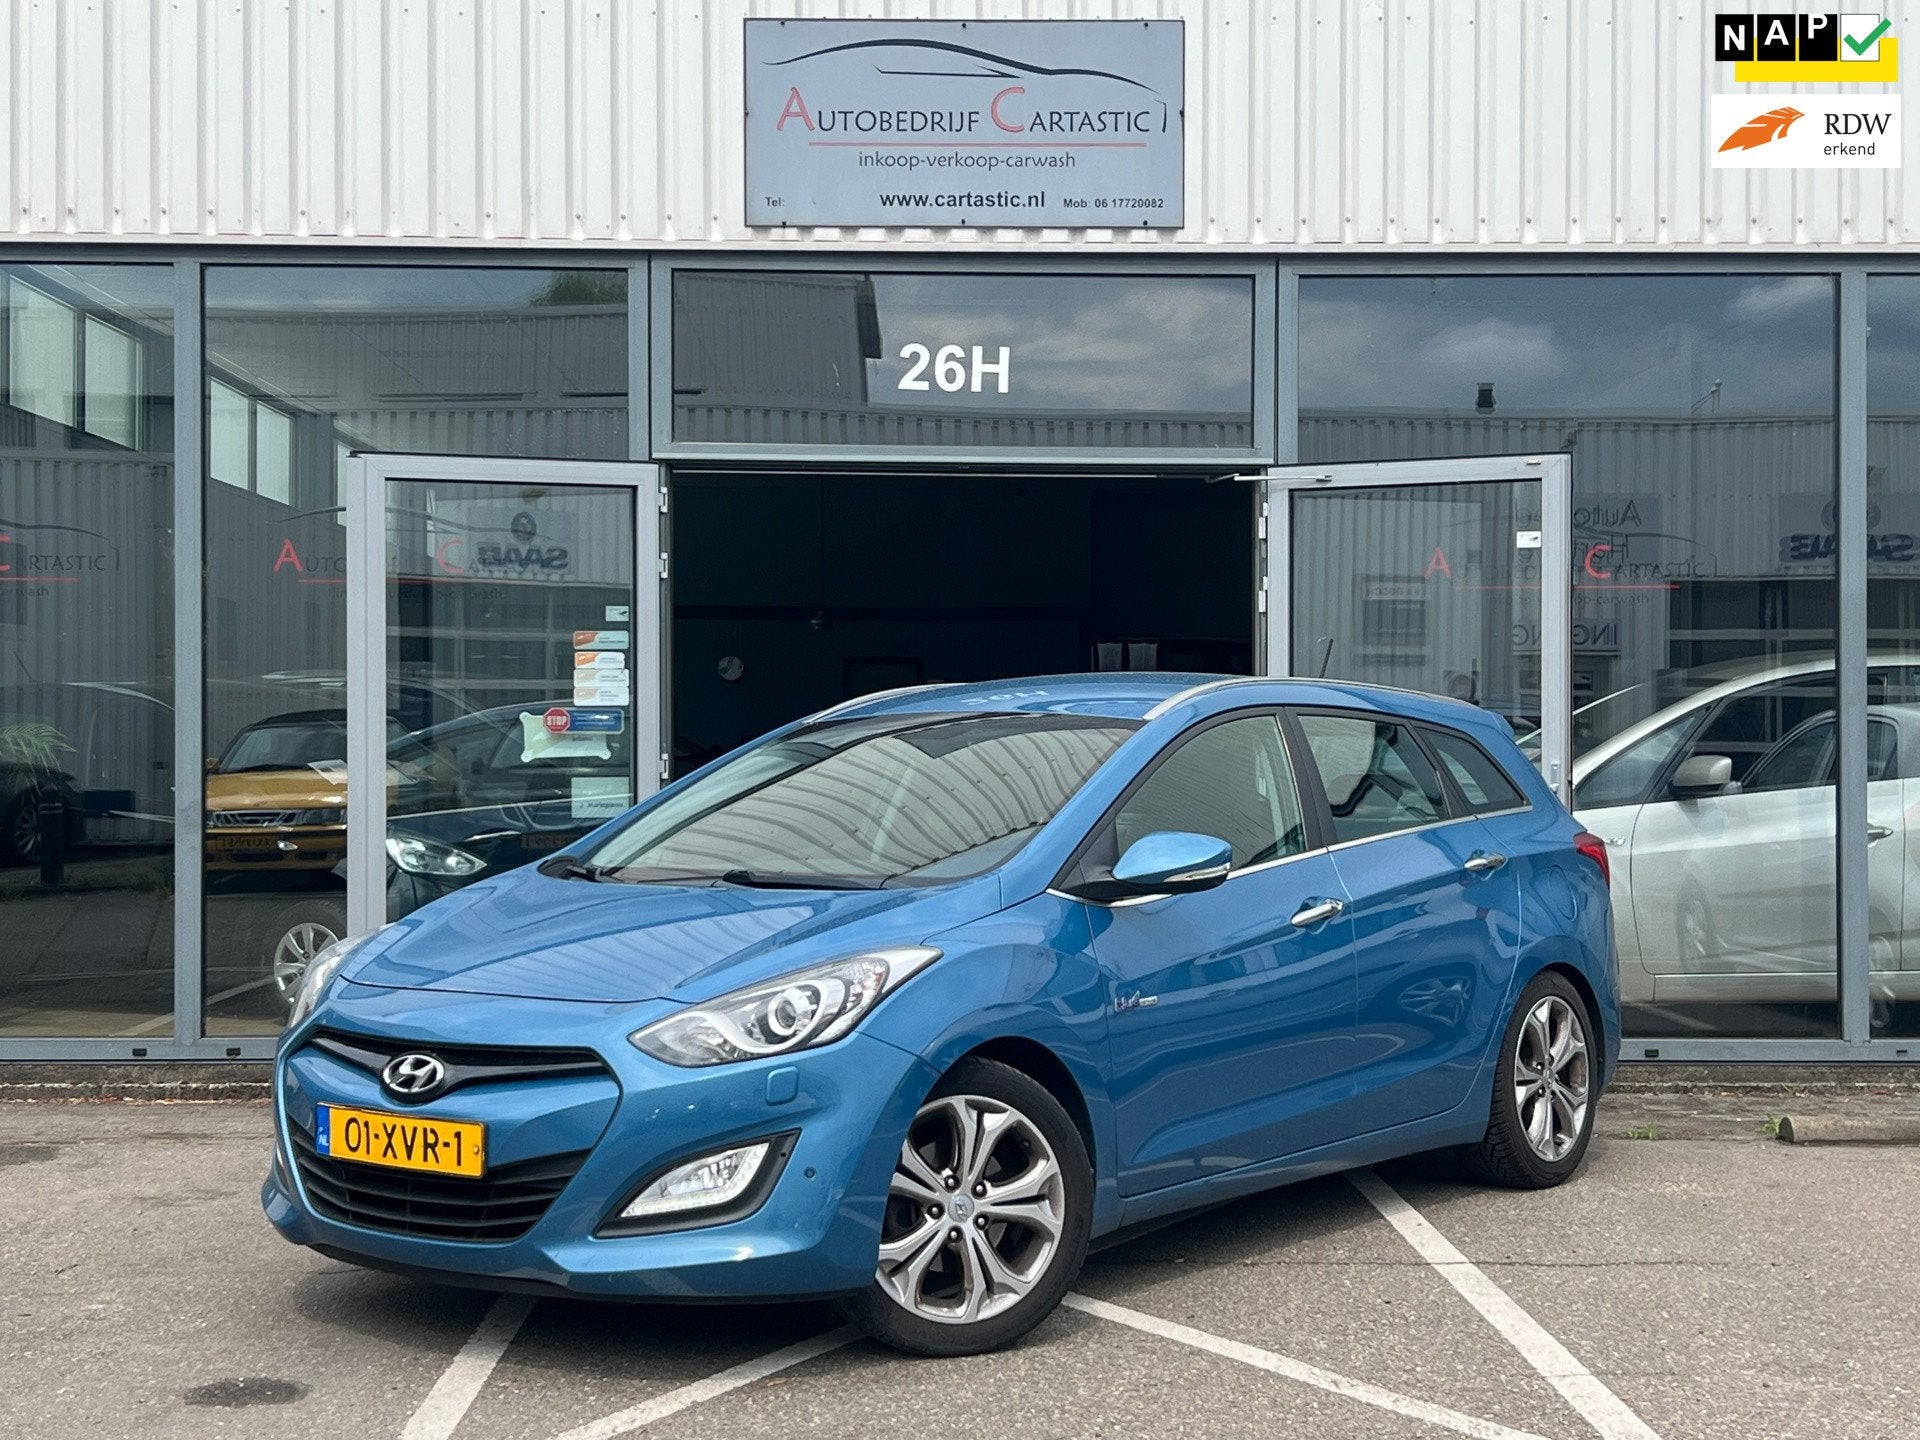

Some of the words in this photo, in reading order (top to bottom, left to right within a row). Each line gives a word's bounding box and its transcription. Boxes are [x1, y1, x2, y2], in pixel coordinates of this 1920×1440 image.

[858, 151, 1076, 171] inkoop-verkoop-carwash
[765, 196, 786, 207] Tel:
[880, 191, 1046, 208] www.cartastic.nl
[1063, 198, 1092, 209] Mob:
[1094, 199, 1108, 208] 06
[1111, 198, 1165, 209] 17720082
[898, 343, 1010, 394] 26H
[547, 716, 567, 726] STOP
[318, 1133, 330, 1147] NL
[345, 1116, 463, 1167] 01-XVR-1
